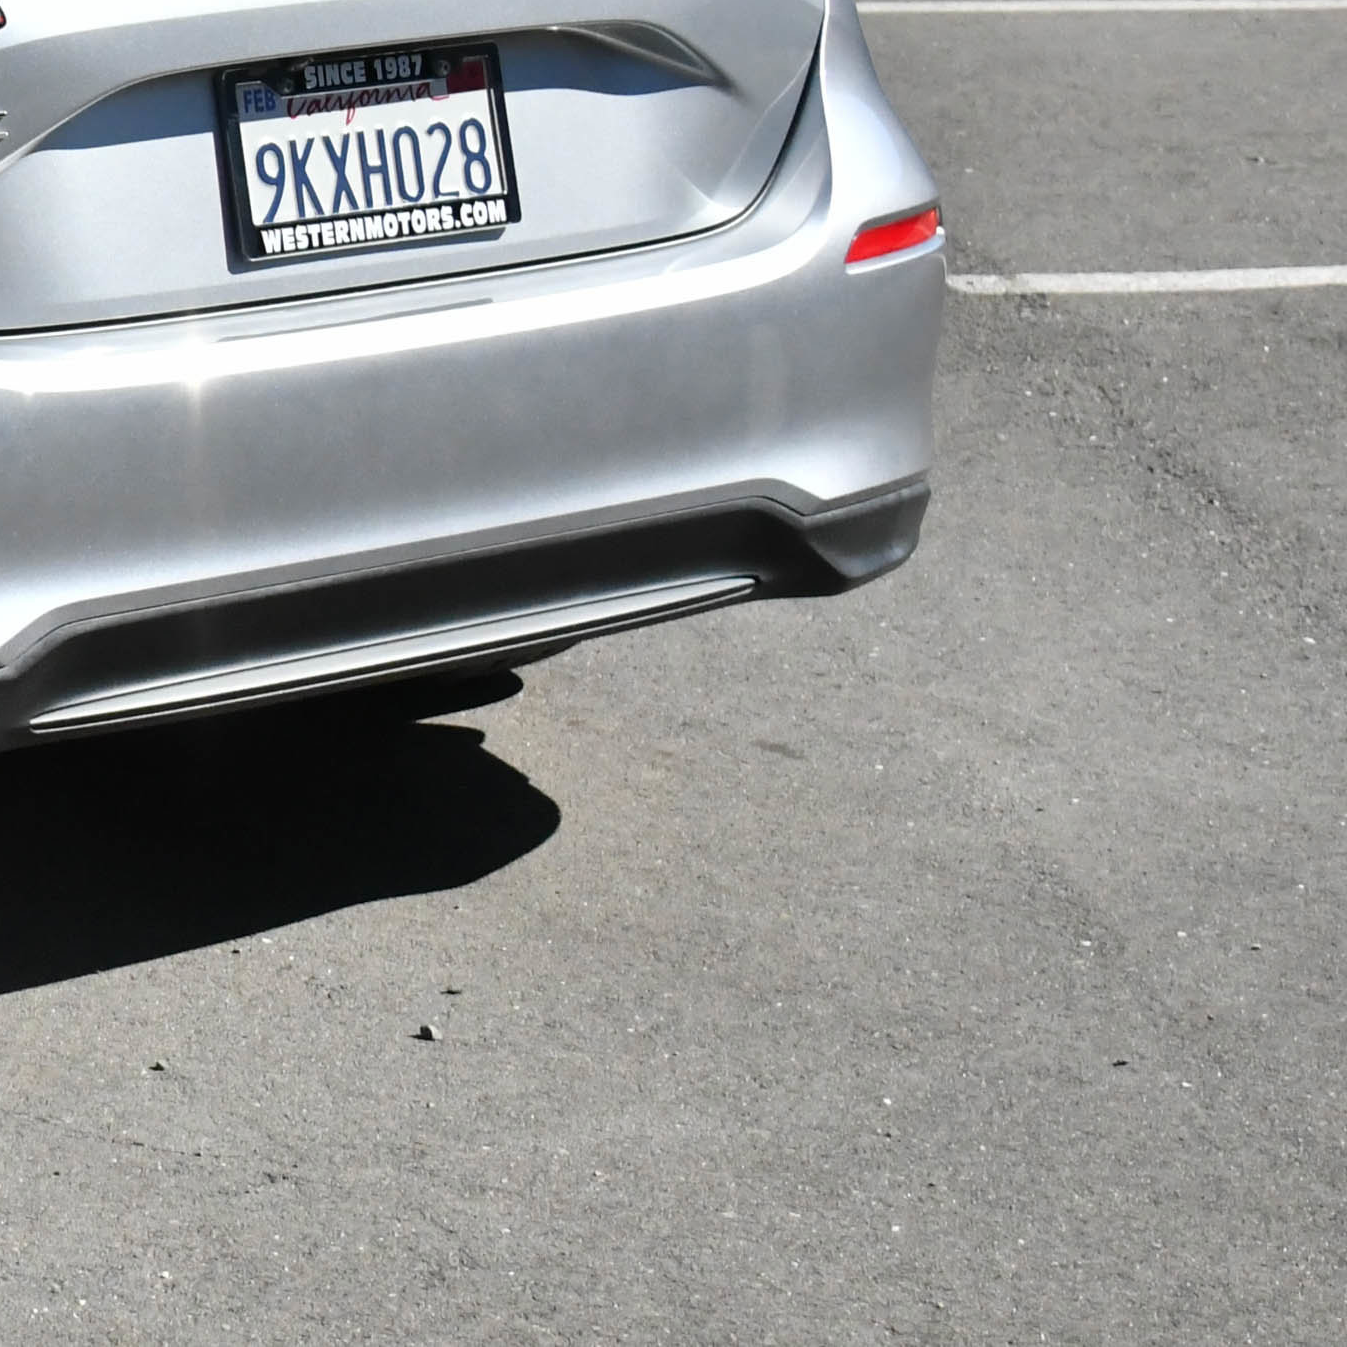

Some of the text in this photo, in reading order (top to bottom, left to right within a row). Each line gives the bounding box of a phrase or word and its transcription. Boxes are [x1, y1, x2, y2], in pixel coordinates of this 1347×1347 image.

[303, 54, 422, 89] SINCE 1987
[242, 88, 276, 113] FEB
[256, 117, 492, 223] 9KXH028
[260, 199, 507, 254] WESTERNMOTORS.COM
